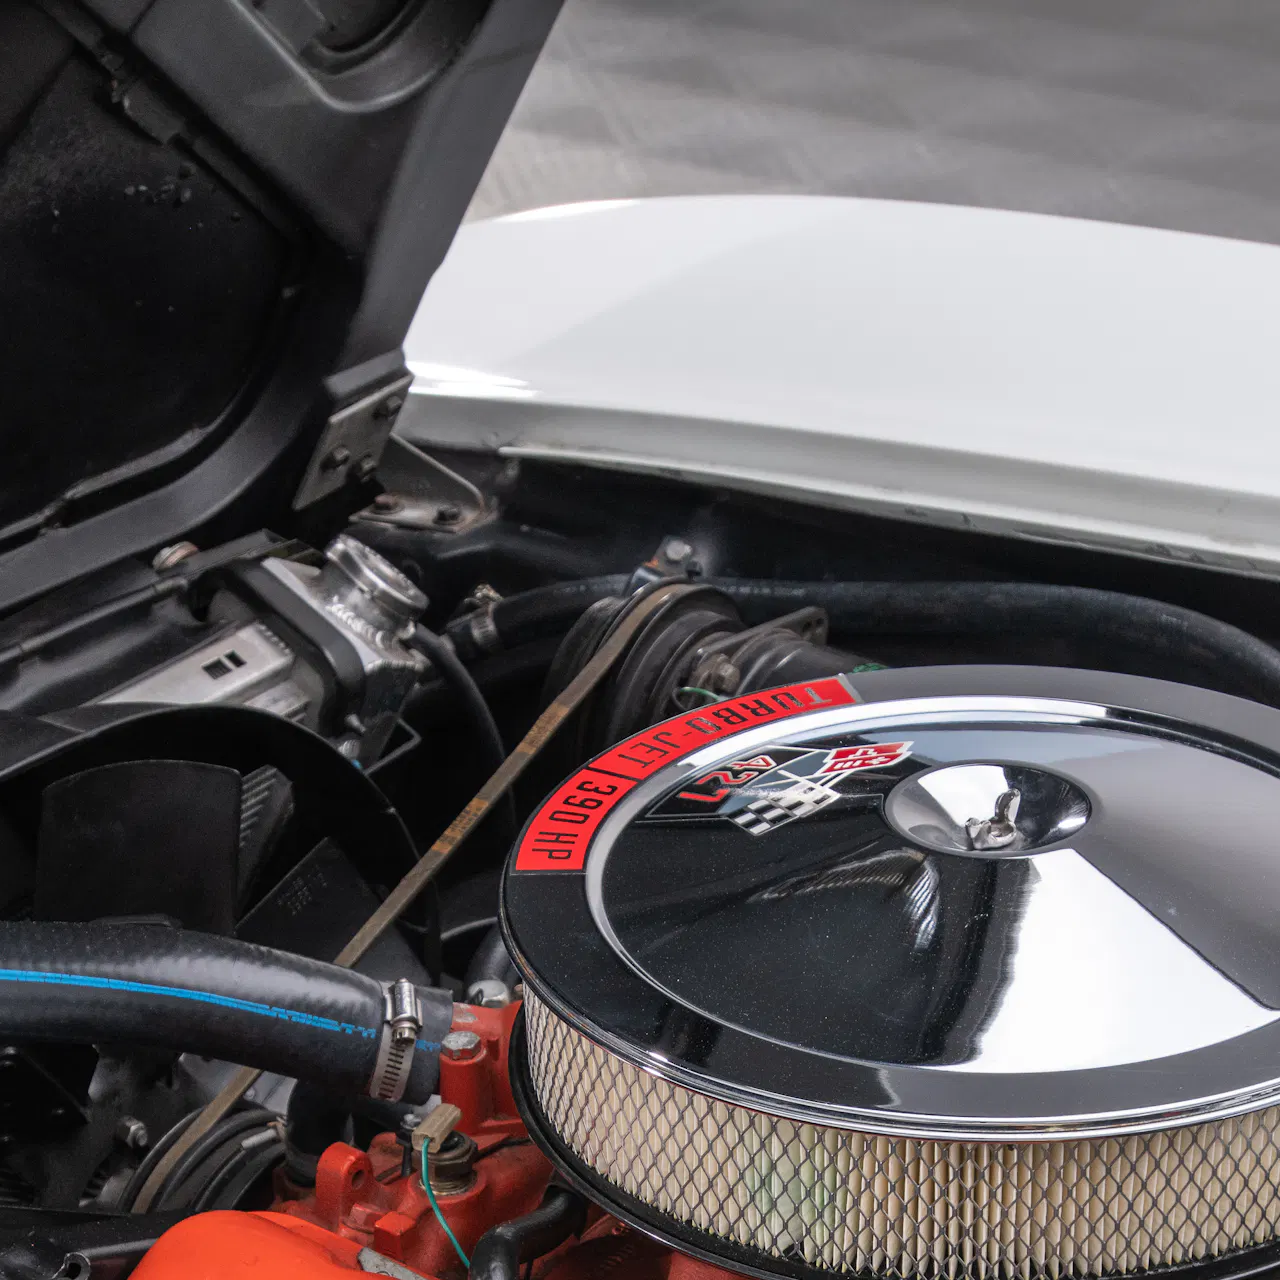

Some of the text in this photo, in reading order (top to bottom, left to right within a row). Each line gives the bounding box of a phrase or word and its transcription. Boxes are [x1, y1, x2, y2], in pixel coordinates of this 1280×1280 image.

[618, 686, 833, 769] TURBO-JET
[676, 754, 777, 803] 427
[548, 780, 618, 827] 390
[531, 830, 579, 861] HP
